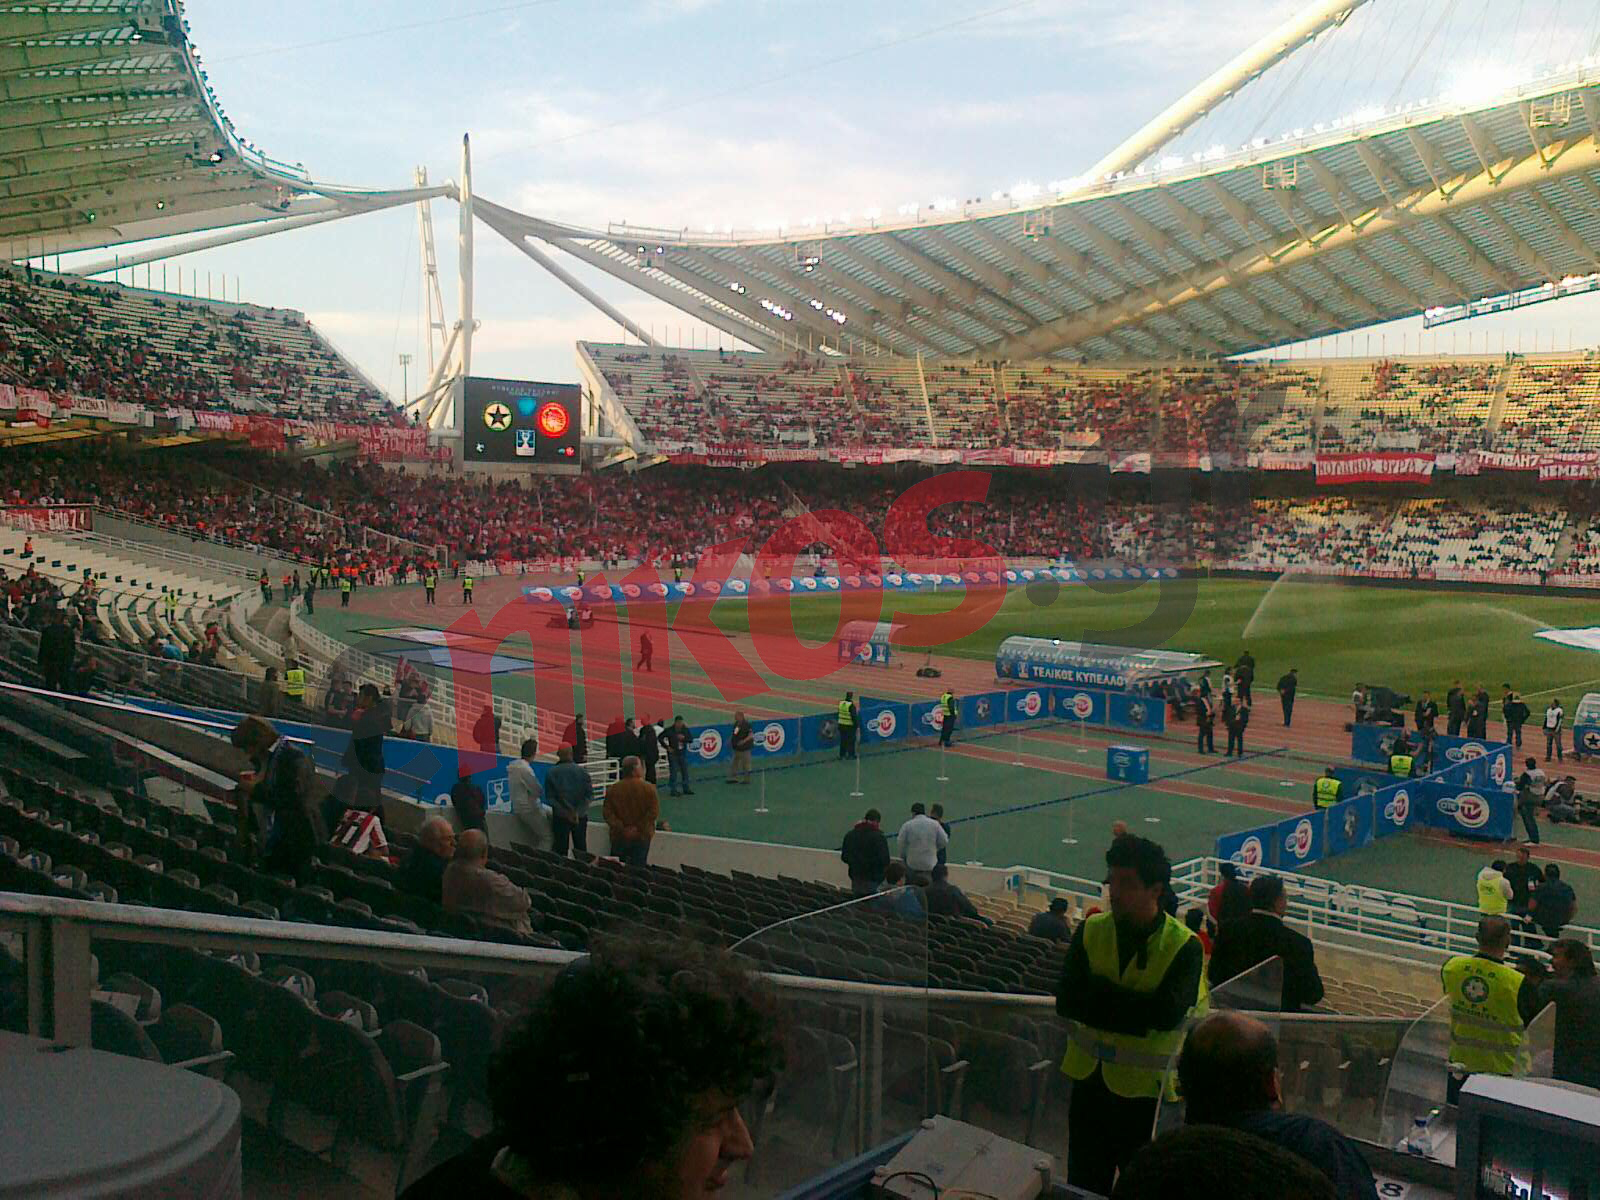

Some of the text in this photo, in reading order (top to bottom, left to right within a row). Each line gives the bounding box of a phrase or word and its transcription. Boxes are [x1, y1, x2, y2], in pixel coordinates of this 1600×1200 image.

[1032, 666, 1073, 681] ΤΕΛΙΚΟΣ
[1441, 801, 1481, 816] OTE TV
